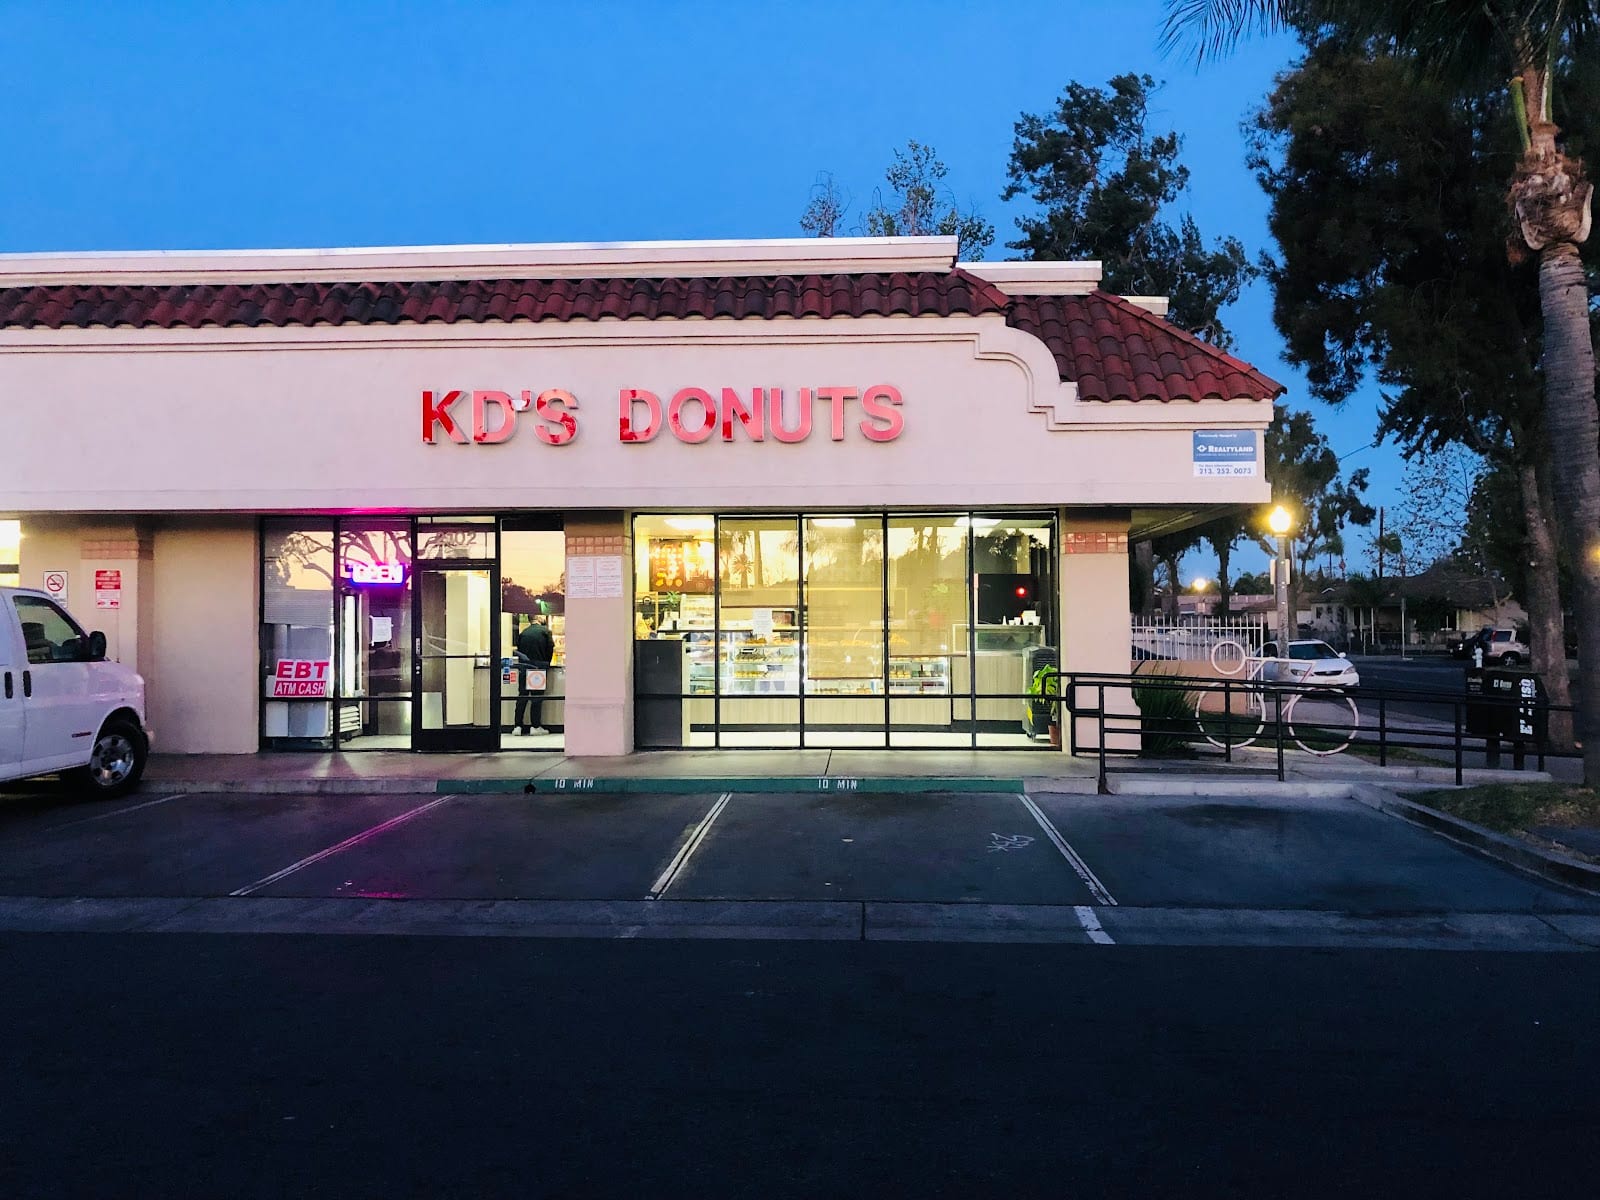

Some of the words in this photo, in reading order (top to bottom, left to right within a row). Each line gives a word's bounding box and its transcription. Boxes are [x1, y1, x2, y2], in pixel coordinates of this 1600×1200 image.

[420, 387, 580, 445] KD'S
[618, 385, 906, 444] DONUTS
[352, 564, 403, 583] OPEN
[277, 661, 330, 679] EBT
[275, 682, 297, 695] ATM
[298, 682, 326, 695] CASH
[554, 778, 567, 789] 10
[573, 777, 595, 789] MIN
[817, 776, 829, 789] 10
[836, 776, 857, 790] MIN
